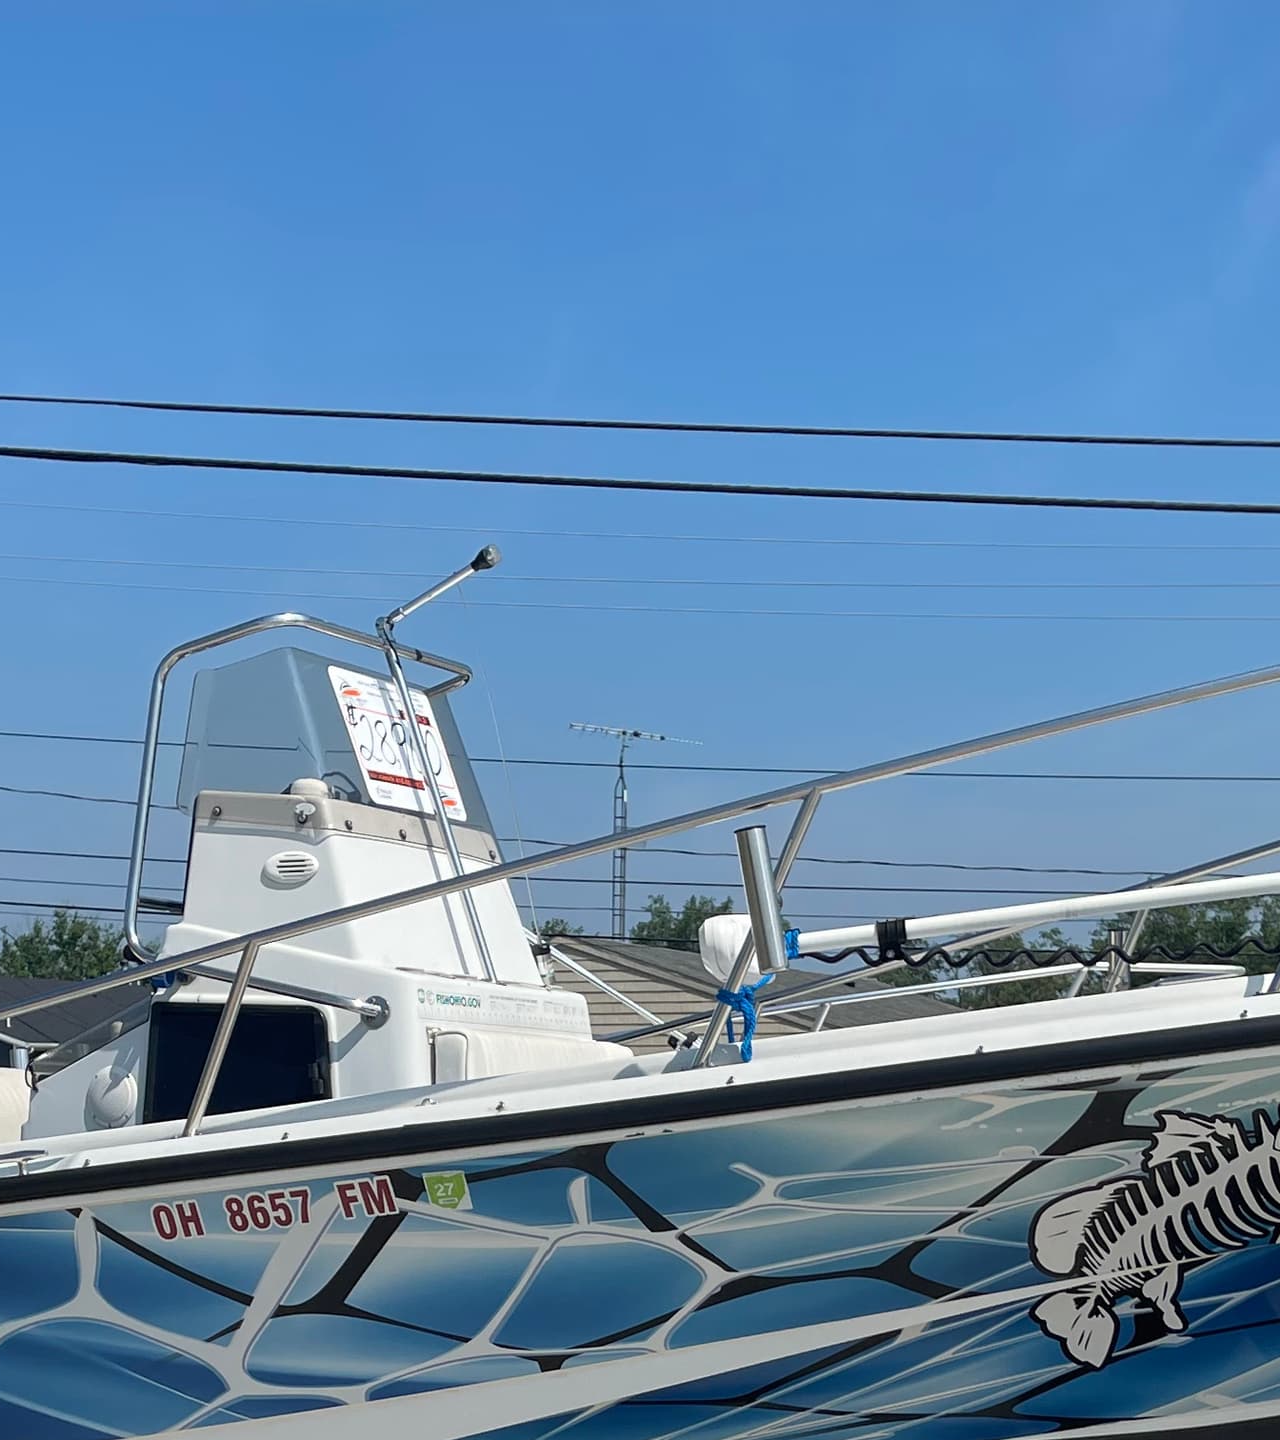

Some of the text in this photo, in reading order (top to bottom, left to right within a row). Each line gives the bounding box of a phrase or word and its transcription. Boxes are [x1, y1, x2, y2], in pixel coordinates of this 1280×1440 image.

[151, 1176, 399, 1241] OH 8657 FM
[434, 1182, 454, 1197] 27
